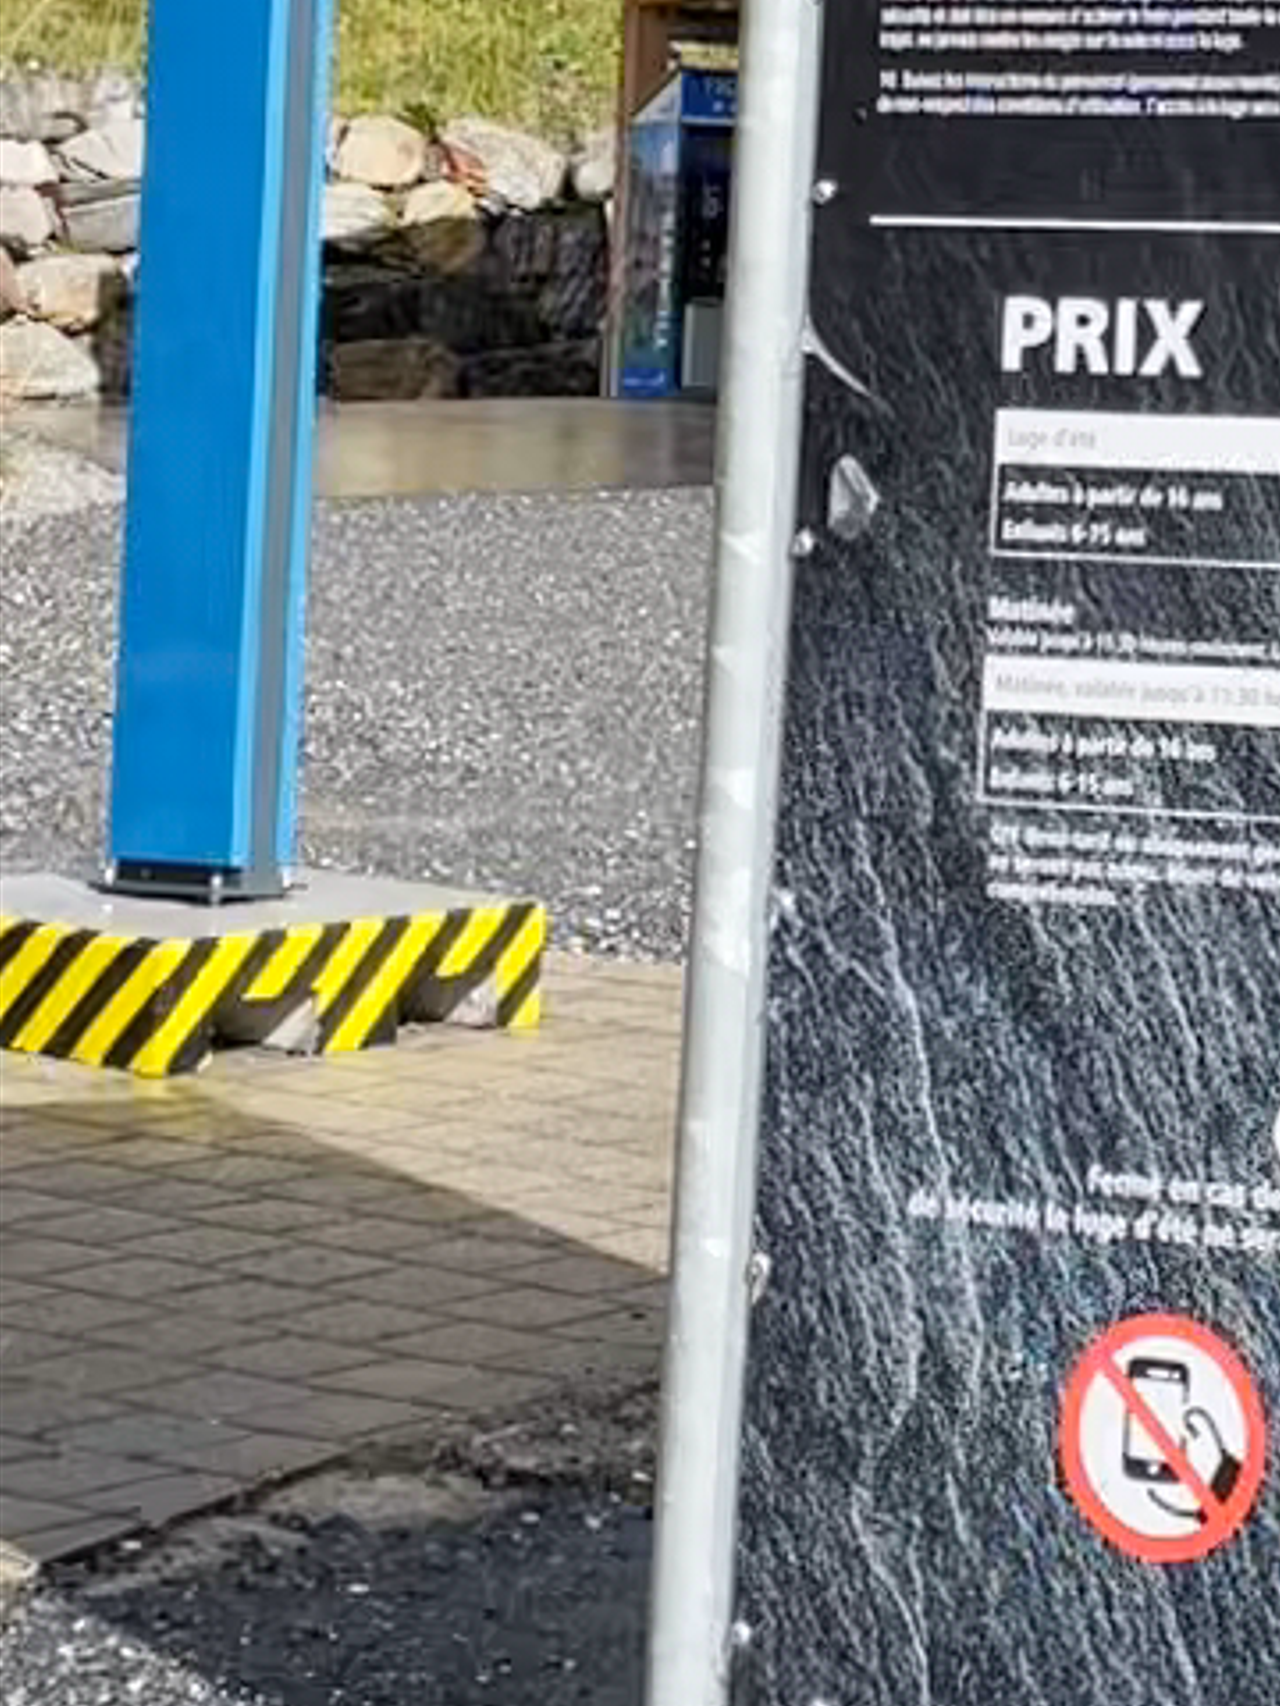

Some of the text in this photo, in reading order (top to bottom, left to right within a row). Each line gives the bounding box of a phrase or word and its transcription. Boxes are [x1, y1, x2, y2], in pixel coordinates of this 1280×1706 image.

[1000, 295, 1202, 378] PRIX
[1139, 486, 1164, 509] de
[1168, 1177, 1200, 1204] en
